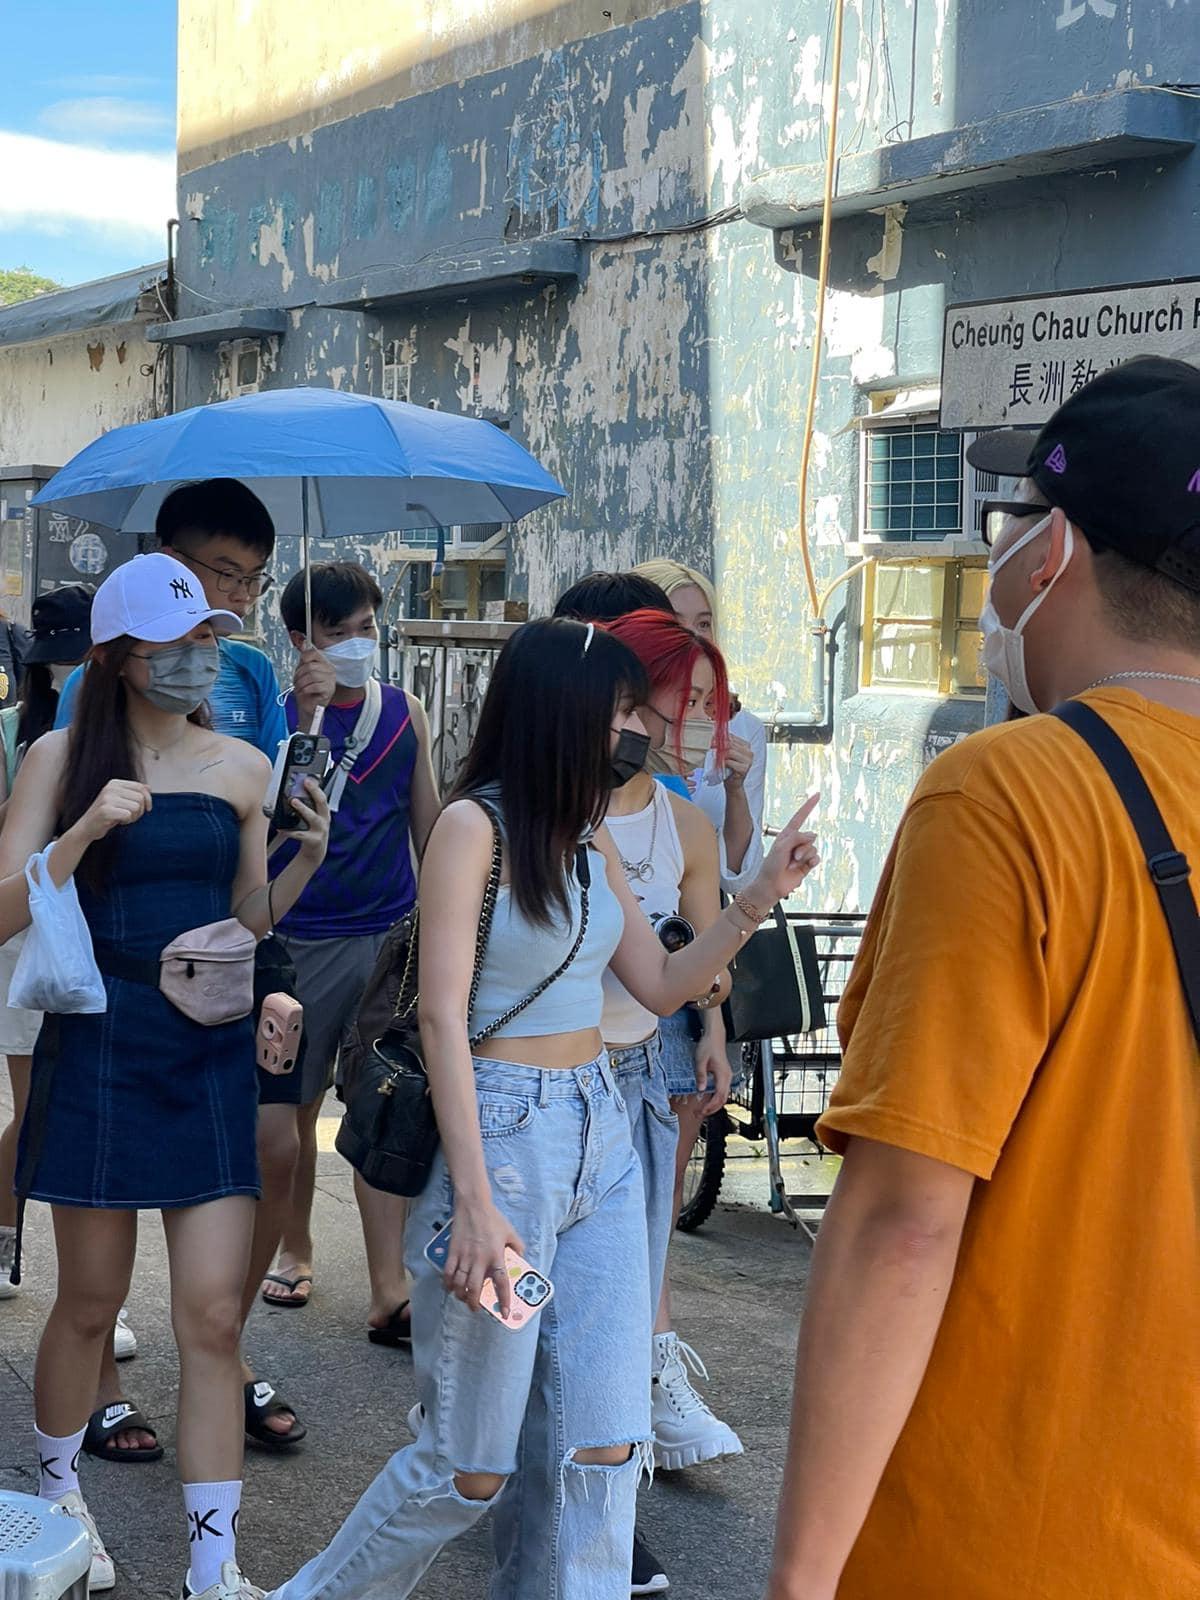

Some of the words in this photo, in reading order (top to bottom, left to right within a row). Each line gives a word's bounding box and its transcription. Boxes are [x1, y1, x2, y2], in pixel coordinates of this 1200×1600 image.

[952, 320, 1025, 350] Cheung
[1032, 310, 1090, 342] Chau
[1097, 303, 1183, 337] Church
[170, 577, 194, 599] NY
[105, 1403, 131, 1419] NIKE
